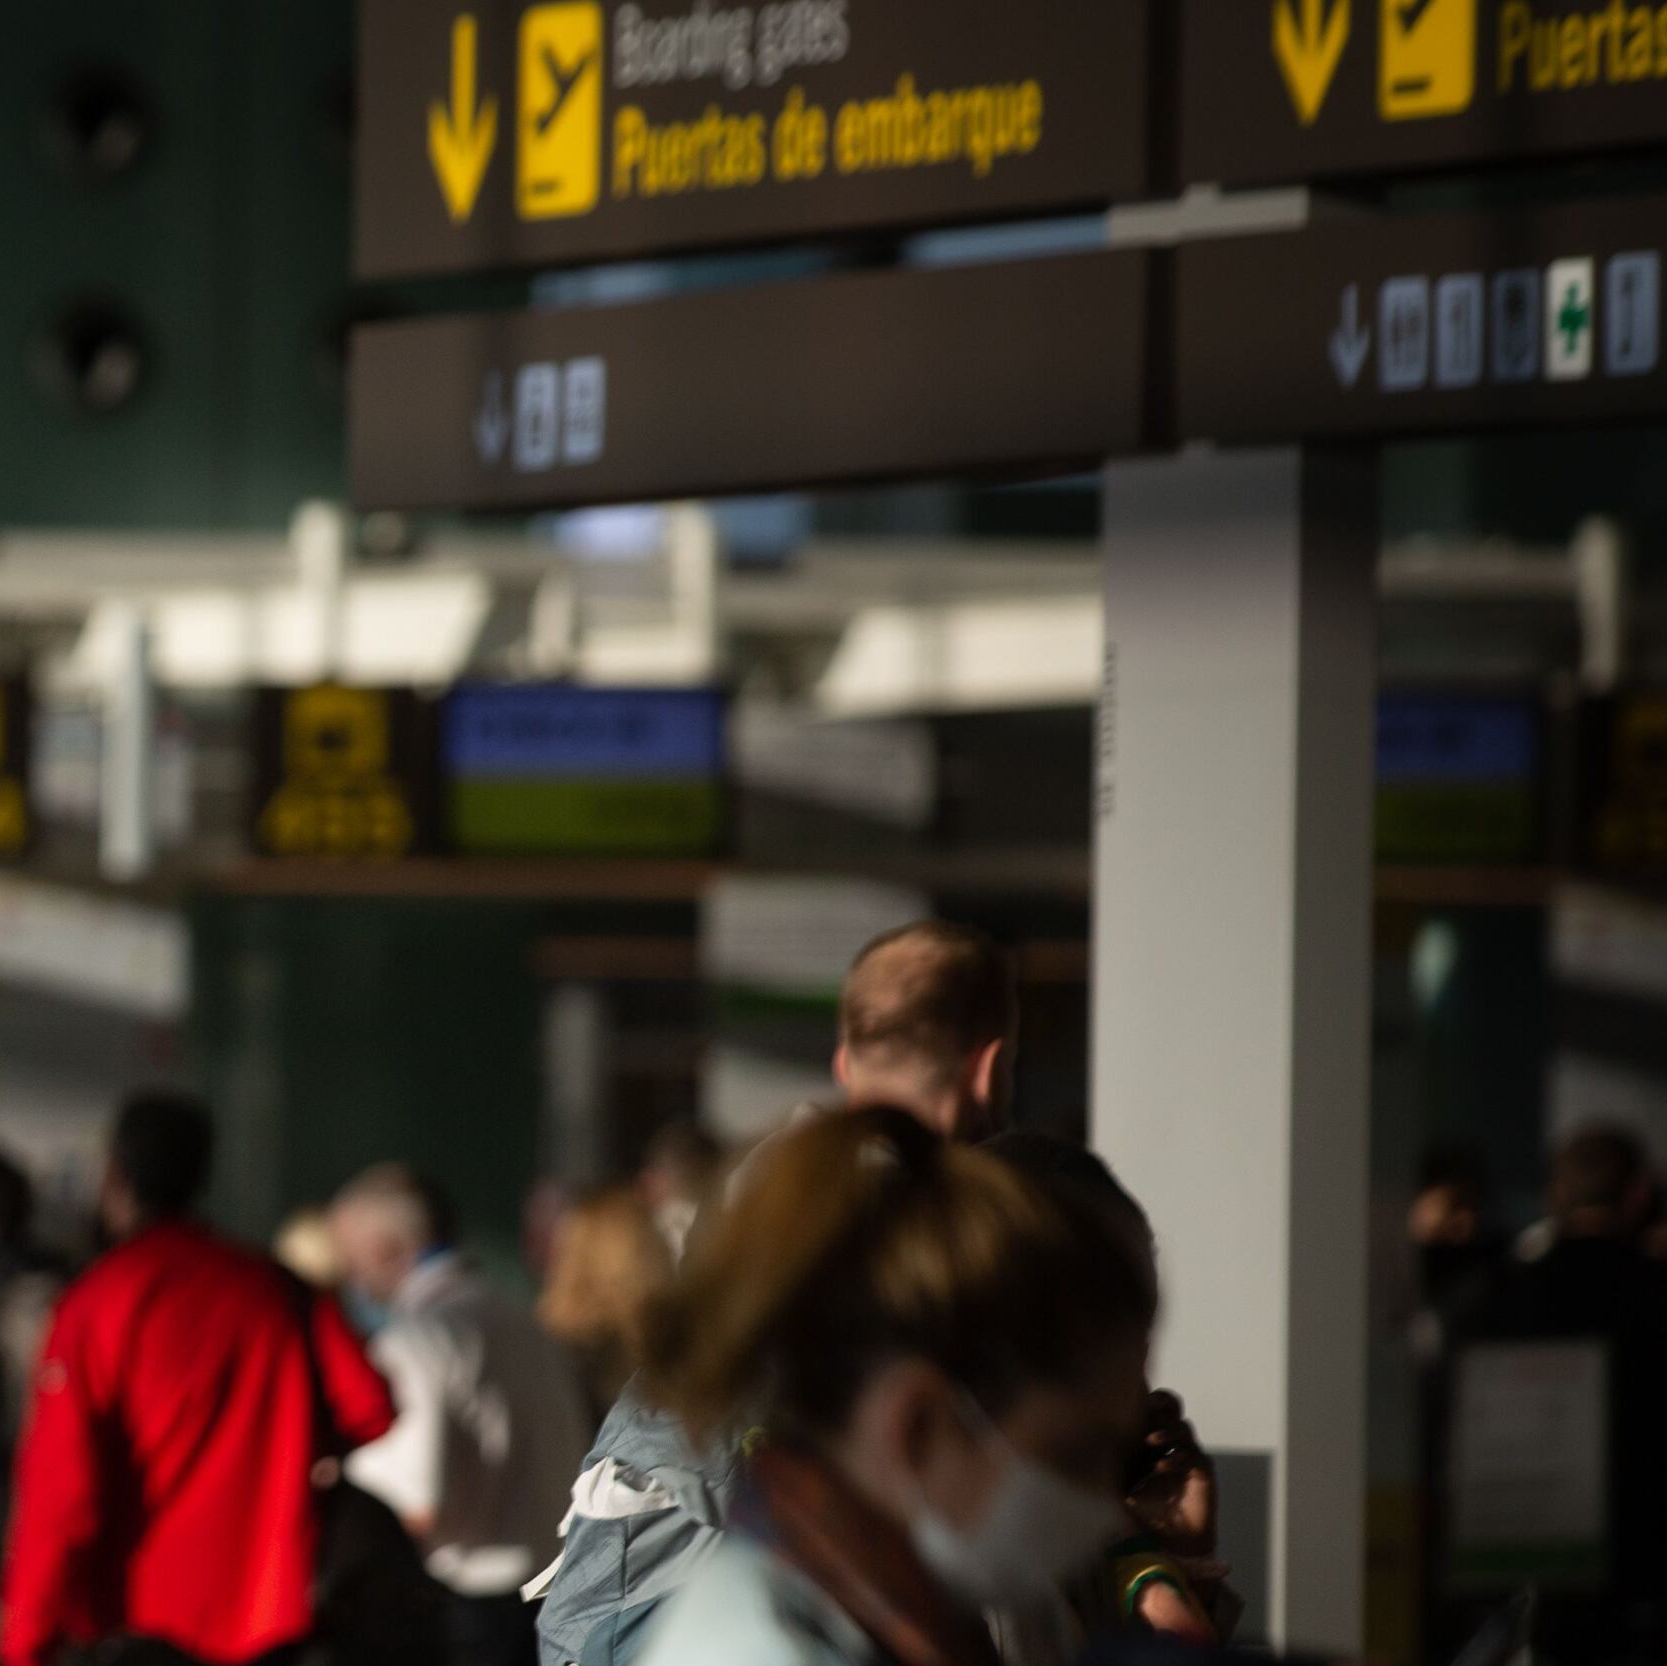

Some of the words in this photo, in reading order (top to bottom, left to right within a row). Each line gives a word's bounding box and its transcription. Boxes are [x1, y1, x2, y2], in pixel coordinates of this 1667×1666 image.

[614, 0, 752, 90] Boarding
[755, 0, 849, 87] gates
[613, 106, 766, 197] Puertas
[772, 84, 827, 182] de
[833, 70, 1044, 179] embarque
